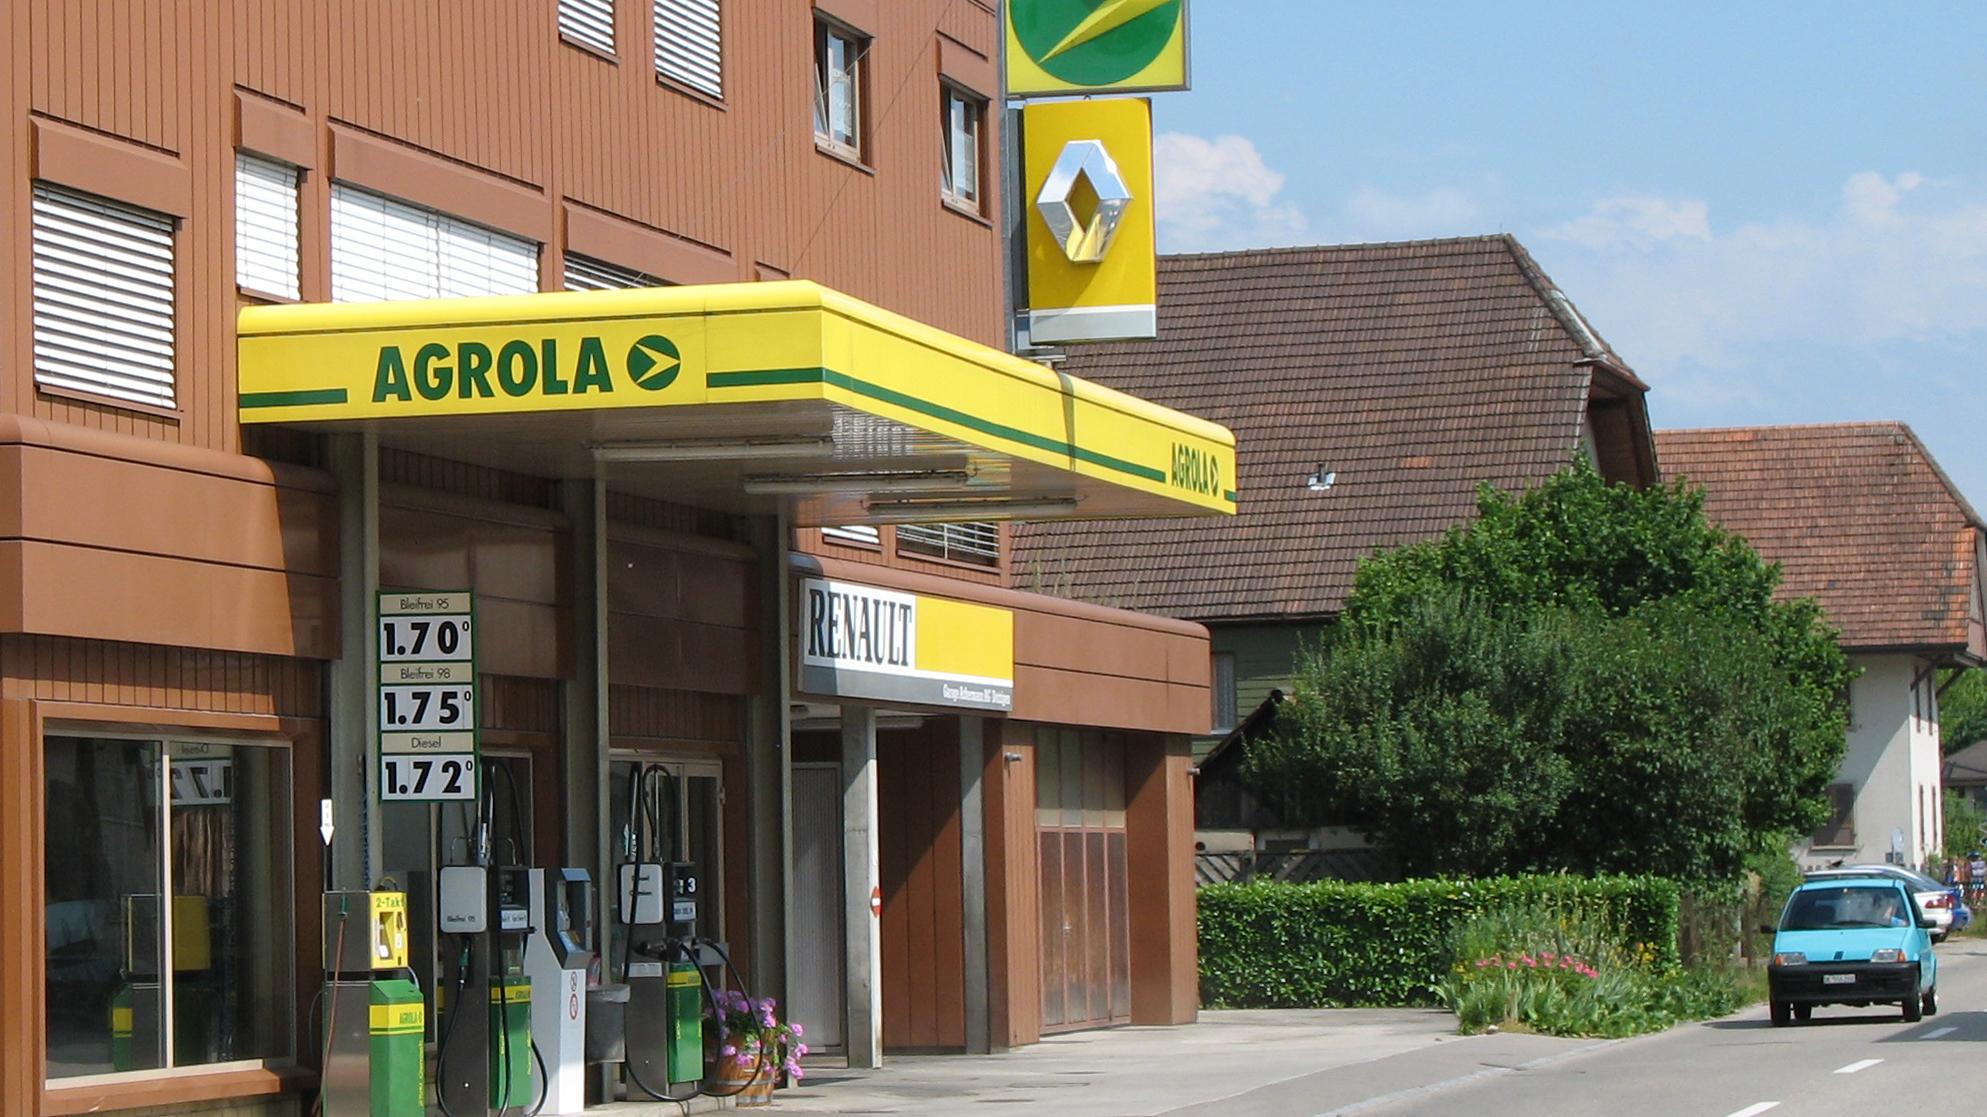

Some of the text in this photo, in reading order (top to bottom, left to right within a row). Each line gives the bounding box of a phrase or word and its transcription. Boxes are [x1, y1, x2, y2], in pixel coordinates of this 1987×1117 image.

[372, 336, 614, 402] AGROLA
[1171, 442, 1209, 495] AGROLA
[400, 597, 450, 610] Bleifrei 95
[808, 588, 913, 667] RENAULT
[400, 667, 451, 680] Bleifrei 98
[411, 735, 442, 749] Diesel
